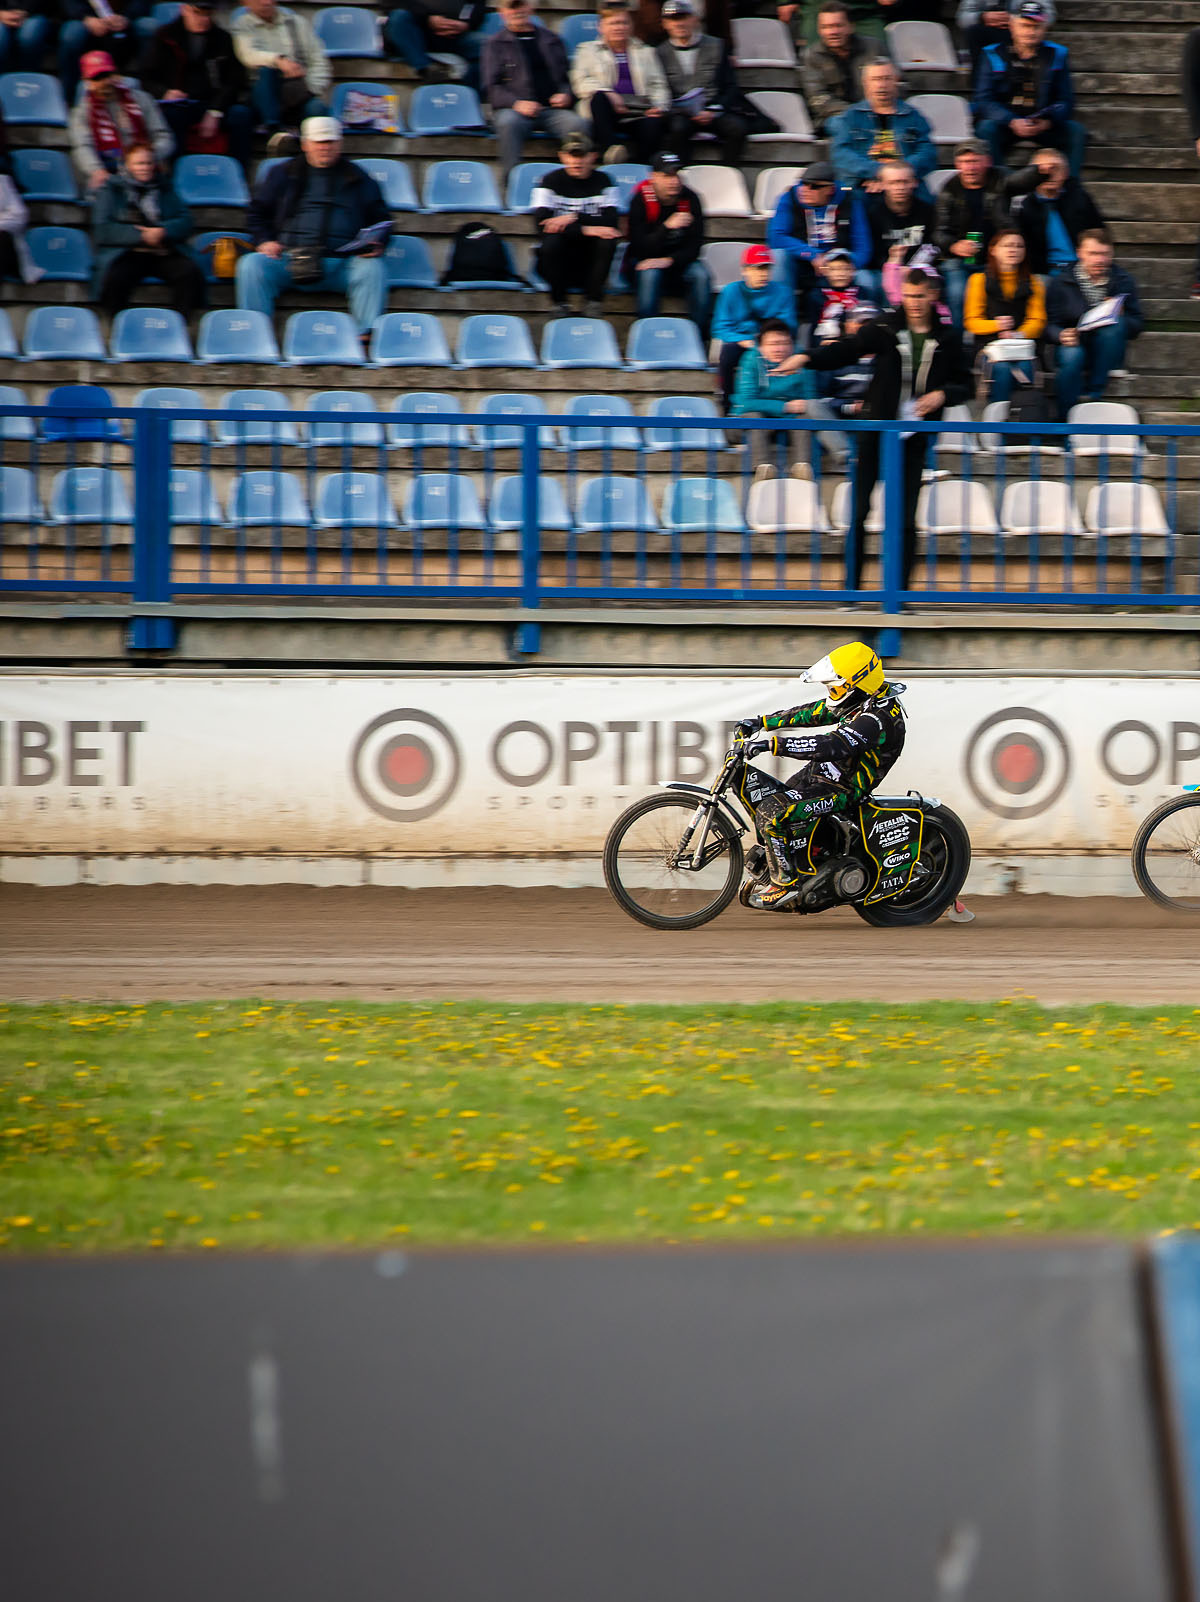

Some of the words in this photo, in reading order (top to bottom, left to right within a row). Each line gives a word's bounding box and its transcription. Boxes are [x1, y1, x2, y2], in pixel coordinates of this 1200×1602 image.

[786, 738, 817, 749] ACDC
[486, 796, 629, 810] SPORT
[813, 799, 835, 813] KIM
[868, 813, 919, 839] METALIKA
[878, 826, 911, 845] ACDC
[888, 852, 911, 864] WIKO
[881, 875, 904, 890] TATA
